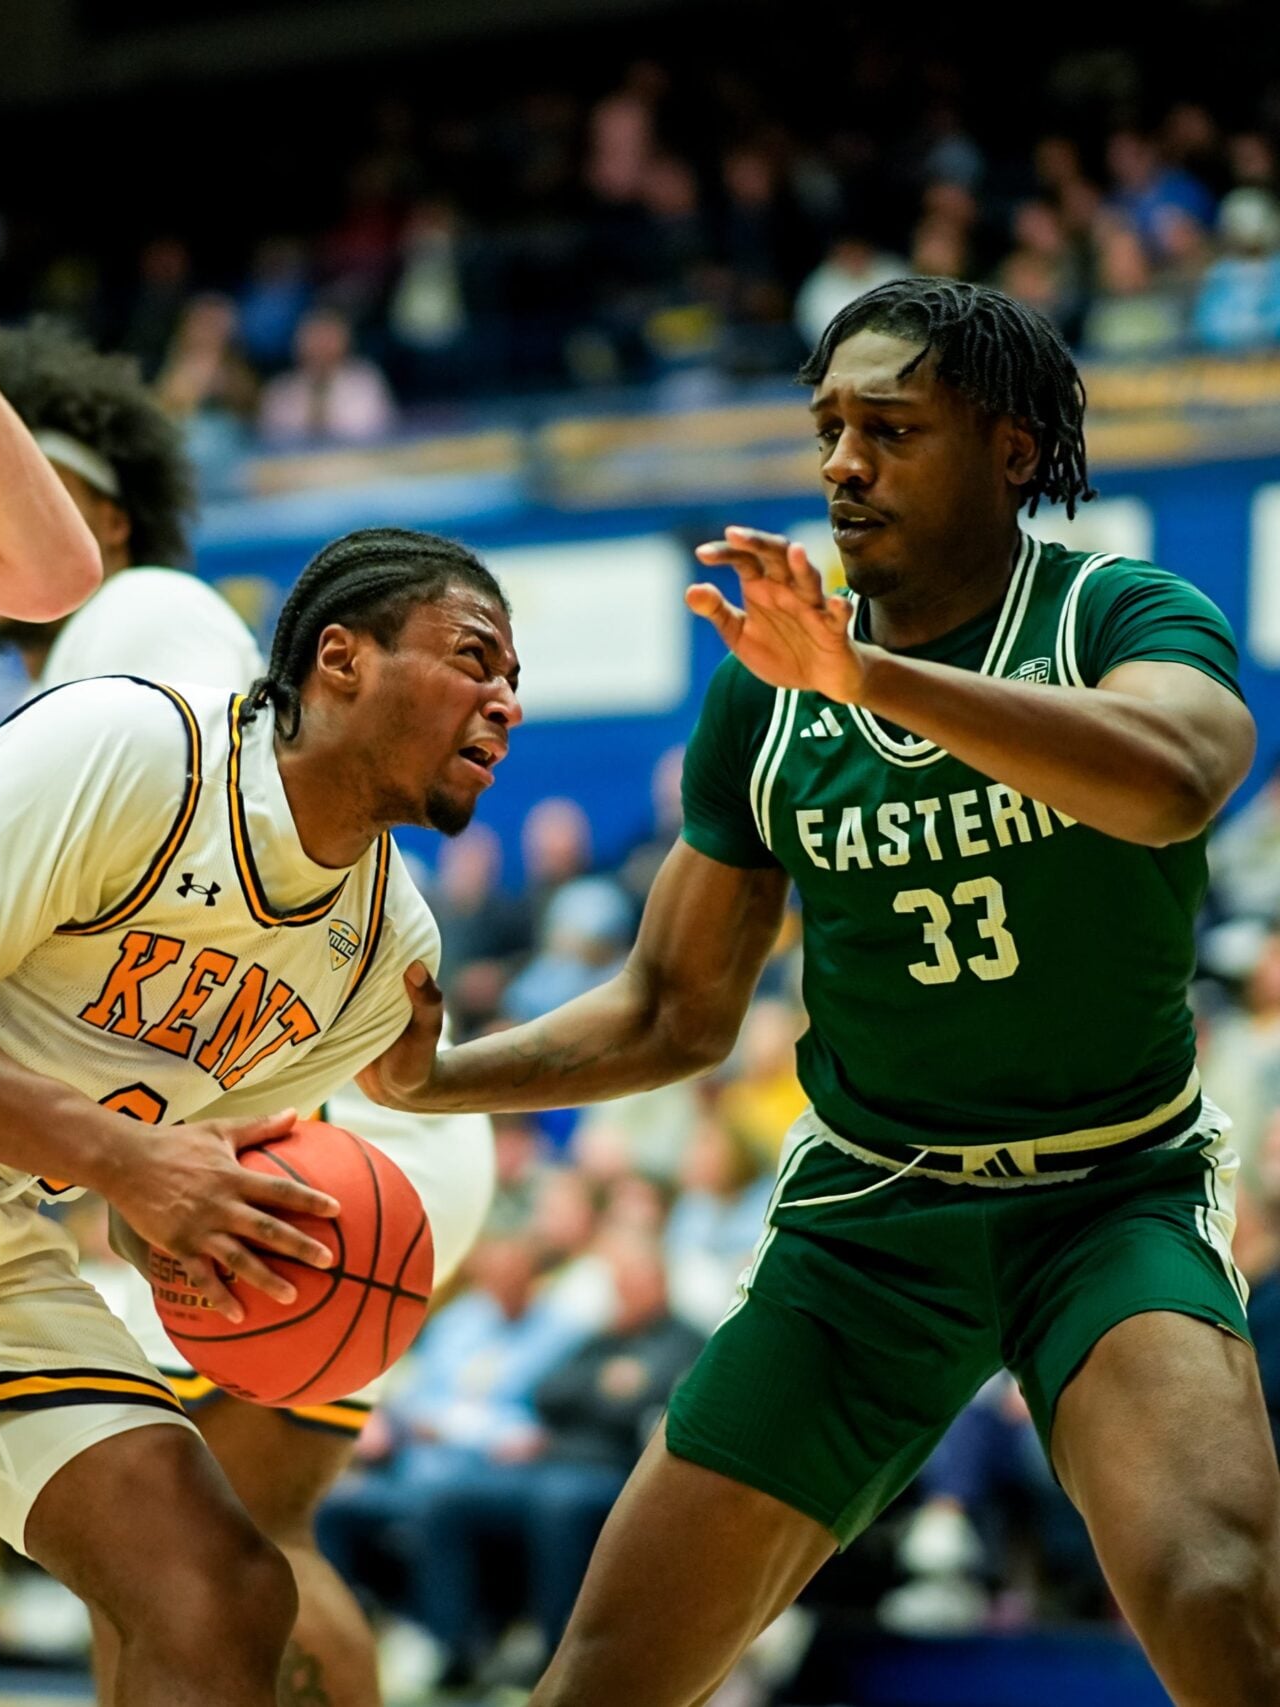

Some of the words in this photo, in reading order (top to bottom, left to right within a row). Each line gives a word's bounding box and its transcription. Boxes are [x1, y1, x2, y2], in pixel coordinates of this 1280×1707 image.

[330, 931, 357, 958] MAC
[892, 876, 1020, 985] 33
[77, 930, 321, 1092] KENT
